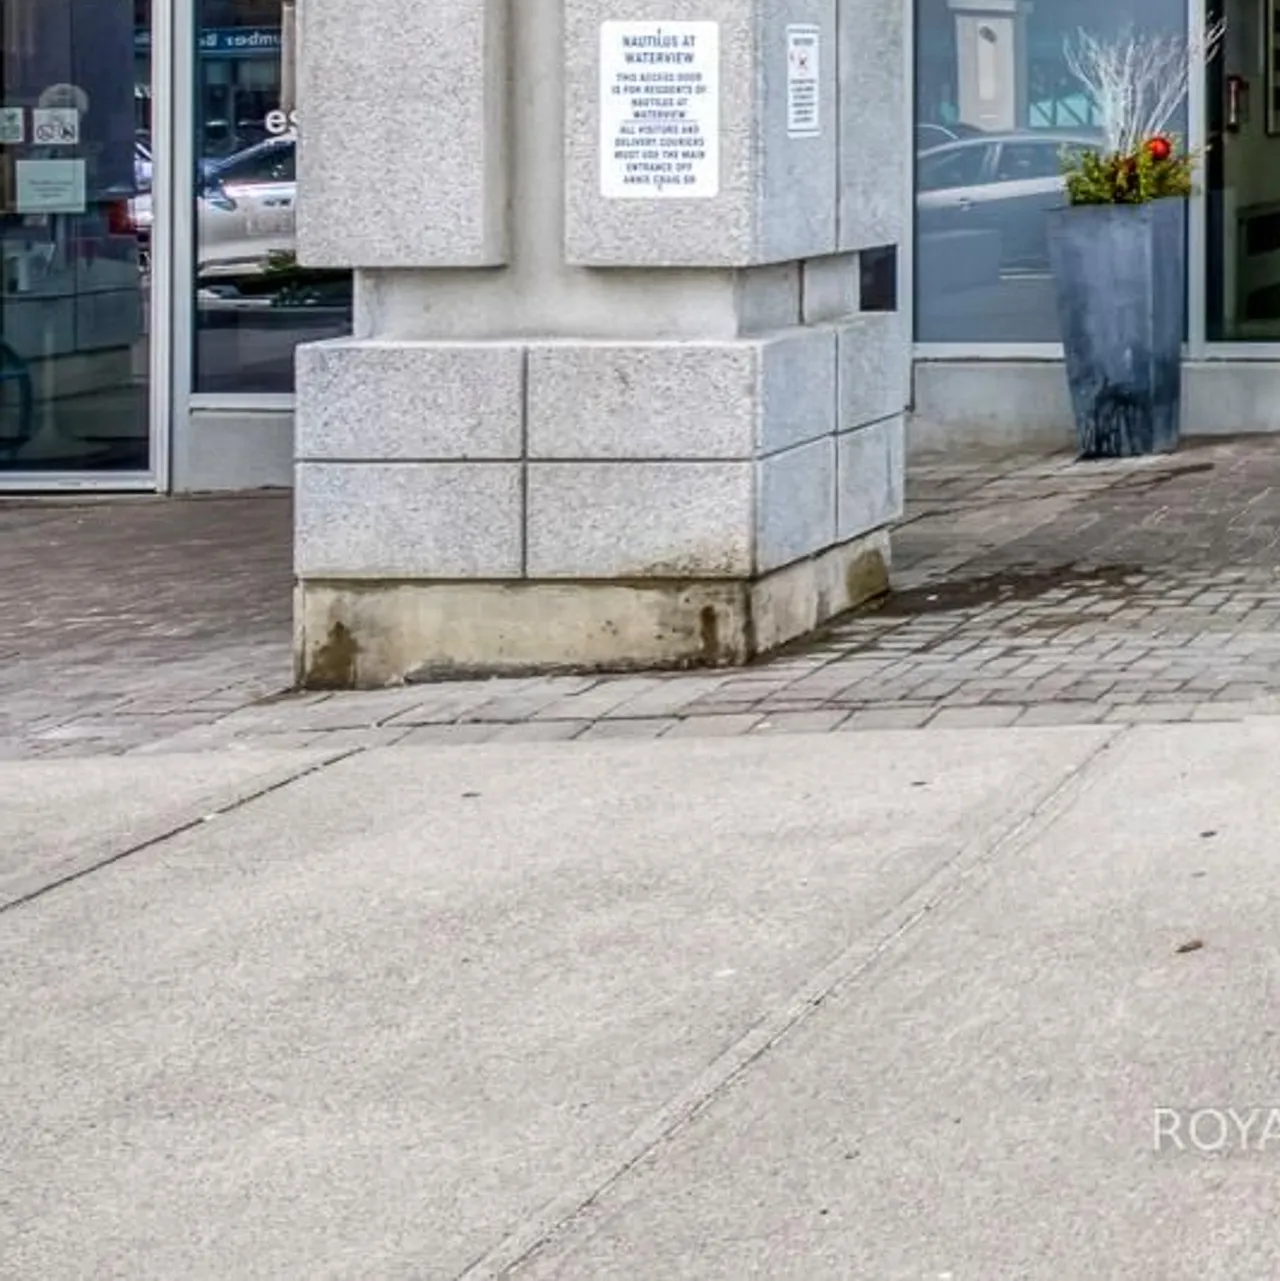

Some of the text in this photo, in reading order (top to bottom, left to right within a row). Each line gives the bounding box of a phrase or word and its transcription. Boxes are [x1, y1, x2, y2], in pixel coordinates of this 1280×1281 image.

[623, 35, 695, 47] NAUTILUS AT
[625, 52, 694, 63] WATERVIEW
[616, 73, 636, 81] THIS
[632, 98, 673, 106] NAUTILUS
[626, 163, 671, 171] ENTRANCE
